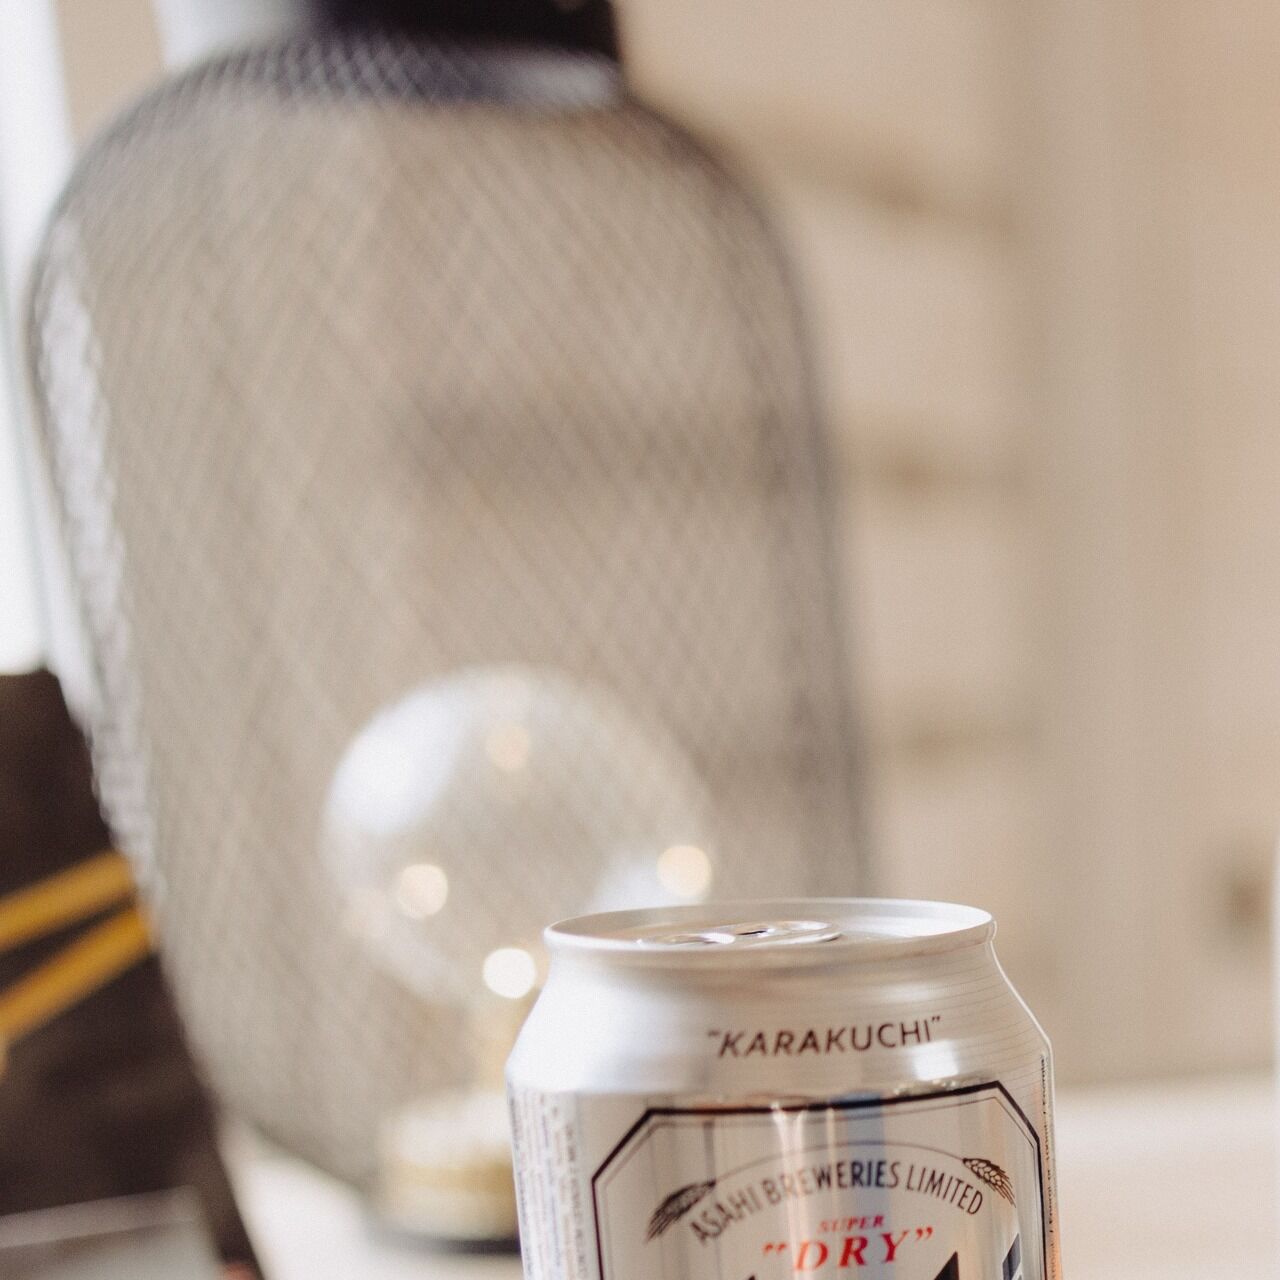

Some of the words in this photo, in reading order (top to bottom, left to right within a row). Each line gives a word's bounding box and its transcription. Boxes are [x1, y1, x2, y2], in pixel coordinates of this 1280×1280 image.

[708, 1016, 941, 1059] "KARAKUCHI"
[690, 1189, 768, 1244] ASAHI
[763, 1161, 900, 1206] BREWERIES
[905, 1165, 984, 1216] LIMITED
[818, 1215, 884, 1233] SUPER
